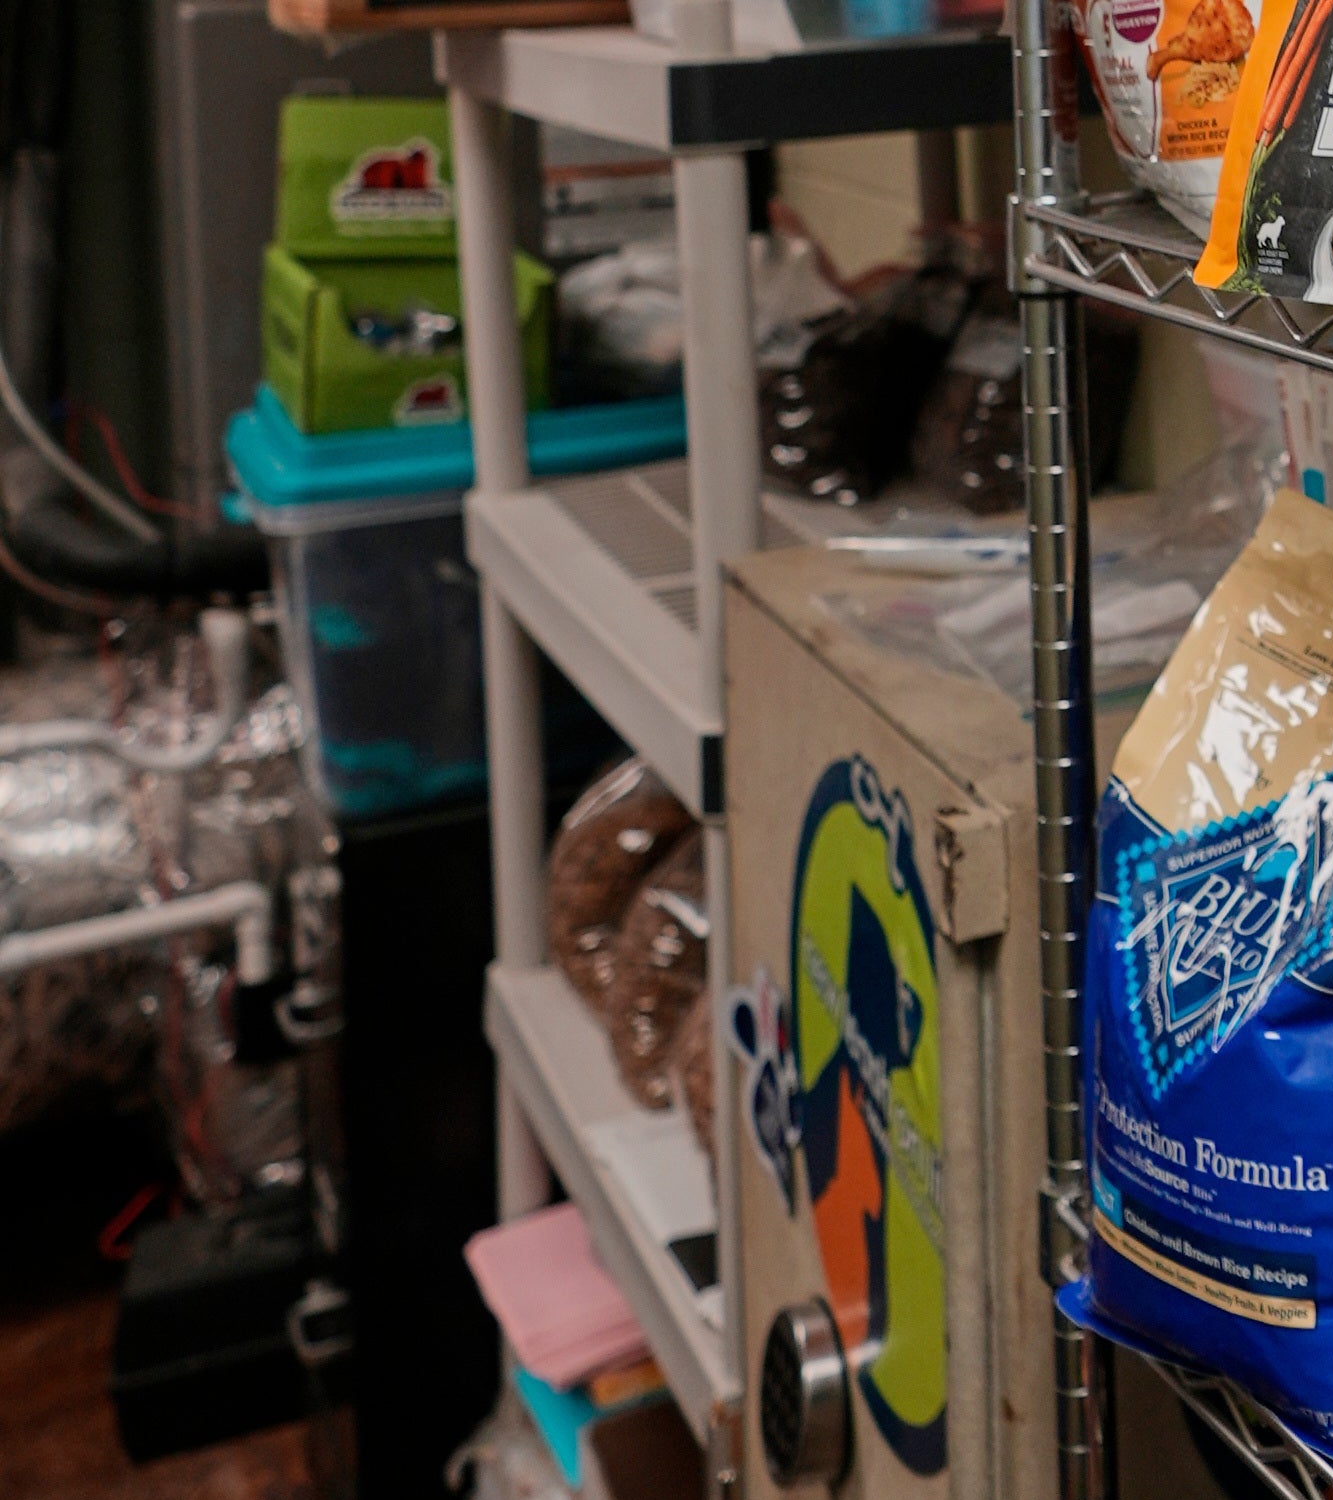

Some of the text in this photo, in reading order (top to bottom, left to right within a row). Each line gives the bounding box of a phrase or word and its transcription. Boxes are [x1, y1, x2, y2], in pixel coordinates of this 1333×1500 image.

[1177, 118, 1208, 132] CHICKEN
[1168, 834, 1242, 872] SUPERIOR
[1194, 1136, 1330, 1193] Formula
[1254, 1219, 1313, 1238] Well-Being
[1162, 1231, 1183, 1254] and
[1183, 1240, 1221, 1268] Brown
[1222, 1255, 1250, 1280] Rice
[1253, 1263, 1308, 1290] Recipe
[1268, 1304, 1309, 1321] Veggies
